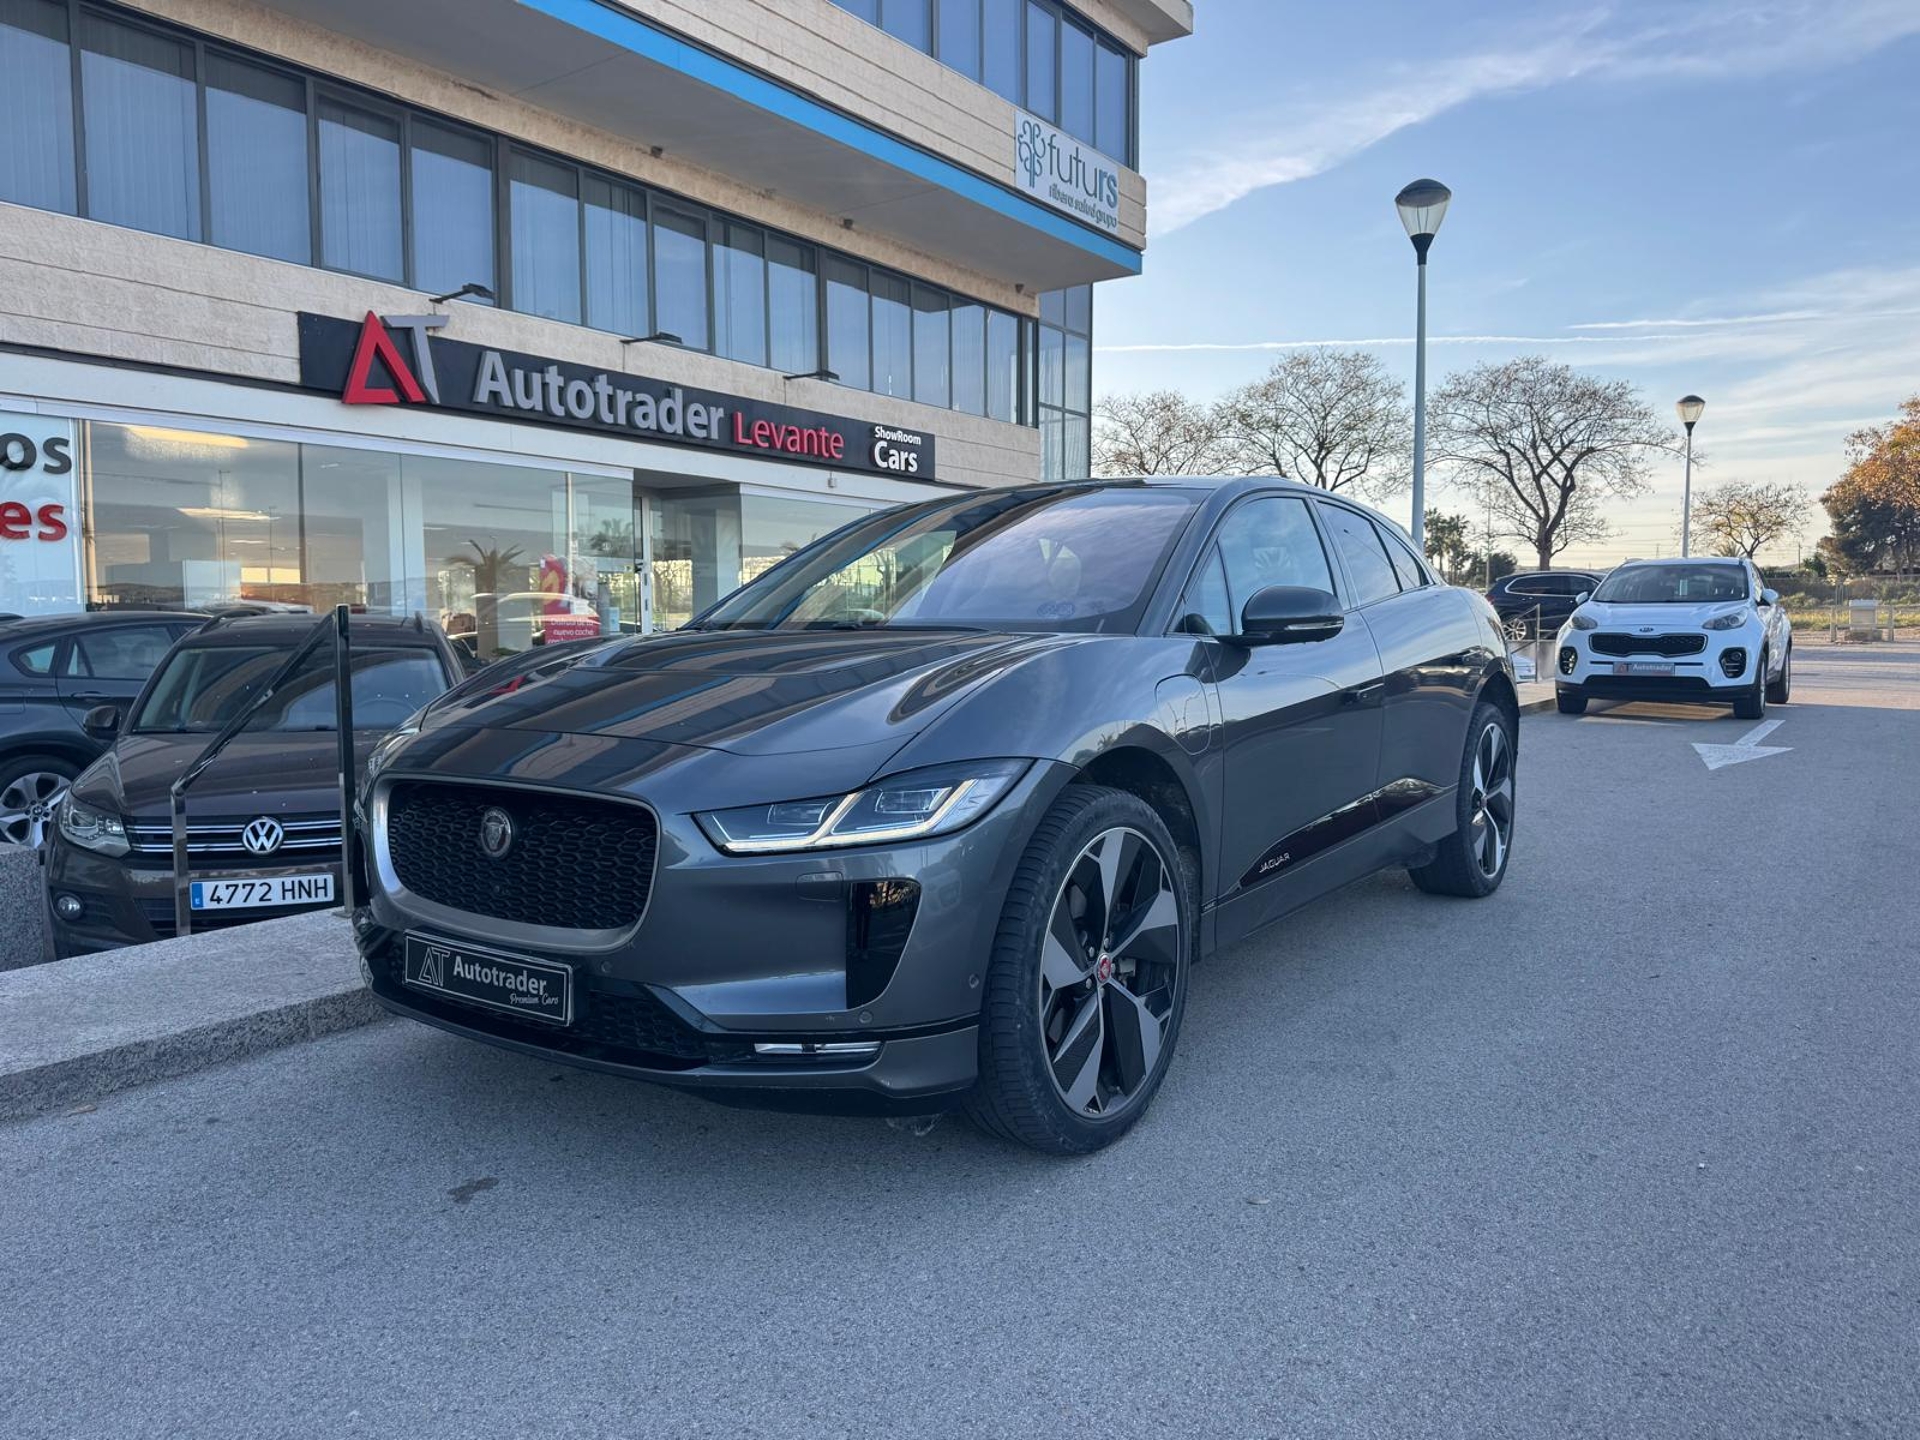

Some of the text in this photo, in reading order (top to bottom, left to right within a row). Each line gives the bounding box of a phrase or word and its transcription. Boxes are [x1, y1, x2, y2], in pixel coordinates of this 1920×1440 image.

[1047, 133, 1118, 209] futurs
[1074, 198, 1097, 218] salud
[1096, 209, 1117, 229] grupo
[473, 350, 724, 440] Autotrader
[732, 411, 845, 459] Levante
[875, 425, 922, 446] ShowRoom
[0, 432, 73, 475] os
[874, 440, 918, 473] Cars
[0, 501, 68, 542] es
[575, 628, 594, 636] coche
[1258, 852, 1291, 873] JAGUAR
[209, 878, 328, 905] 4772 HNH
[452, 955, 547, 996] Autotrader
[541, 992, 559, 1006] Cars
